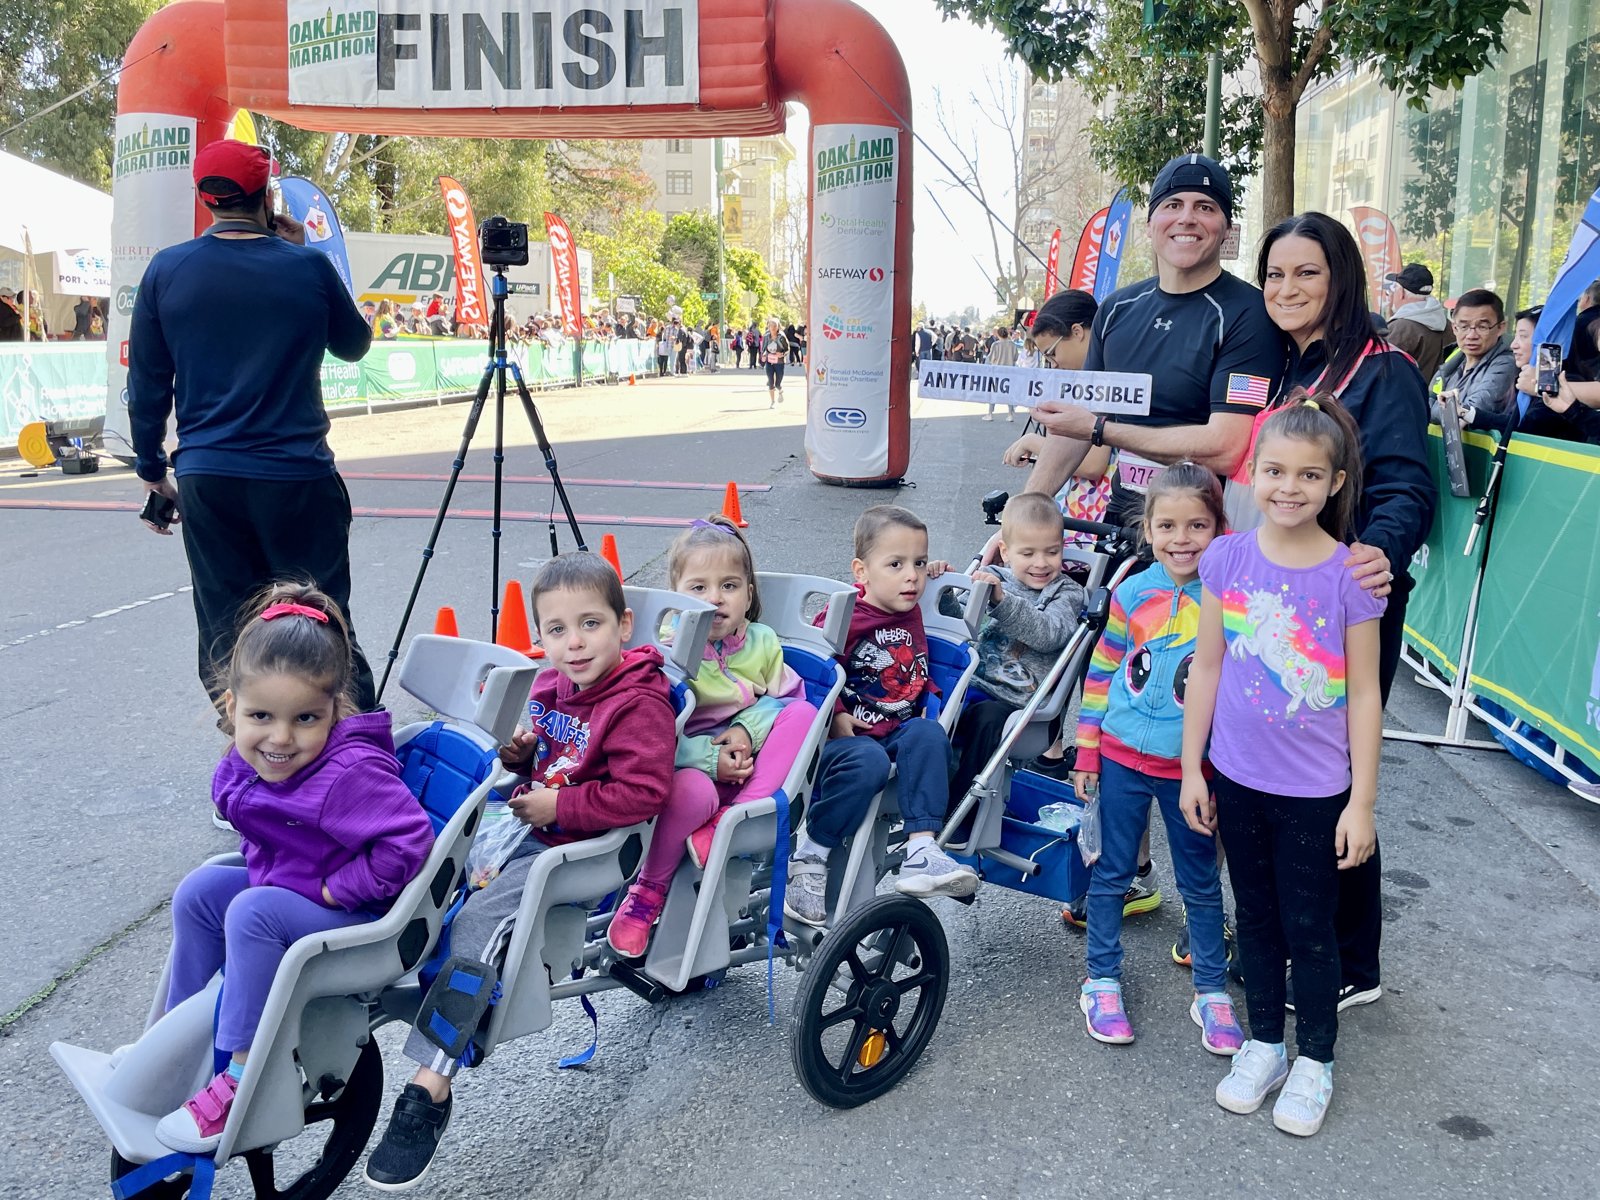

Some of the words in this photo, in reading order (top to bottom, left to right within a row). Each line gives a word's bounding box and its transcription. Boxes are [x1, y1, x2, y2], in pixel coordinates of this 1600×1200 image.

[289, 7, 376, 44] OAKLAND
[289, 37, 376, 68] MARATHON
[378, 8, 684, 92] FINISH
[117, 122, 190, 158] OAKLAND
[817, 134, 893, 170] OAKLAND
[116, 150, 190, 178] MARATHON
[817, 162, 893, 193] MARATHON
[114, 246, 160, 256] HERITA
[59, 275, 81, 285] PORT
[818, 268, 867, 280] SAFEWAY
[330, 362, 361, 380] Health
[852, 369, 884, 377] McDonald
[322, 384, 337, 398] ntal
[338, 382, 358, 398] Care
[924, 371, 1010, 394] ANYTHING
[1028, 380, 1043, 397] IS
[1060, 382, 1144, 404] POSSIBLE
[875, 628, 912, 646] WEBBED
